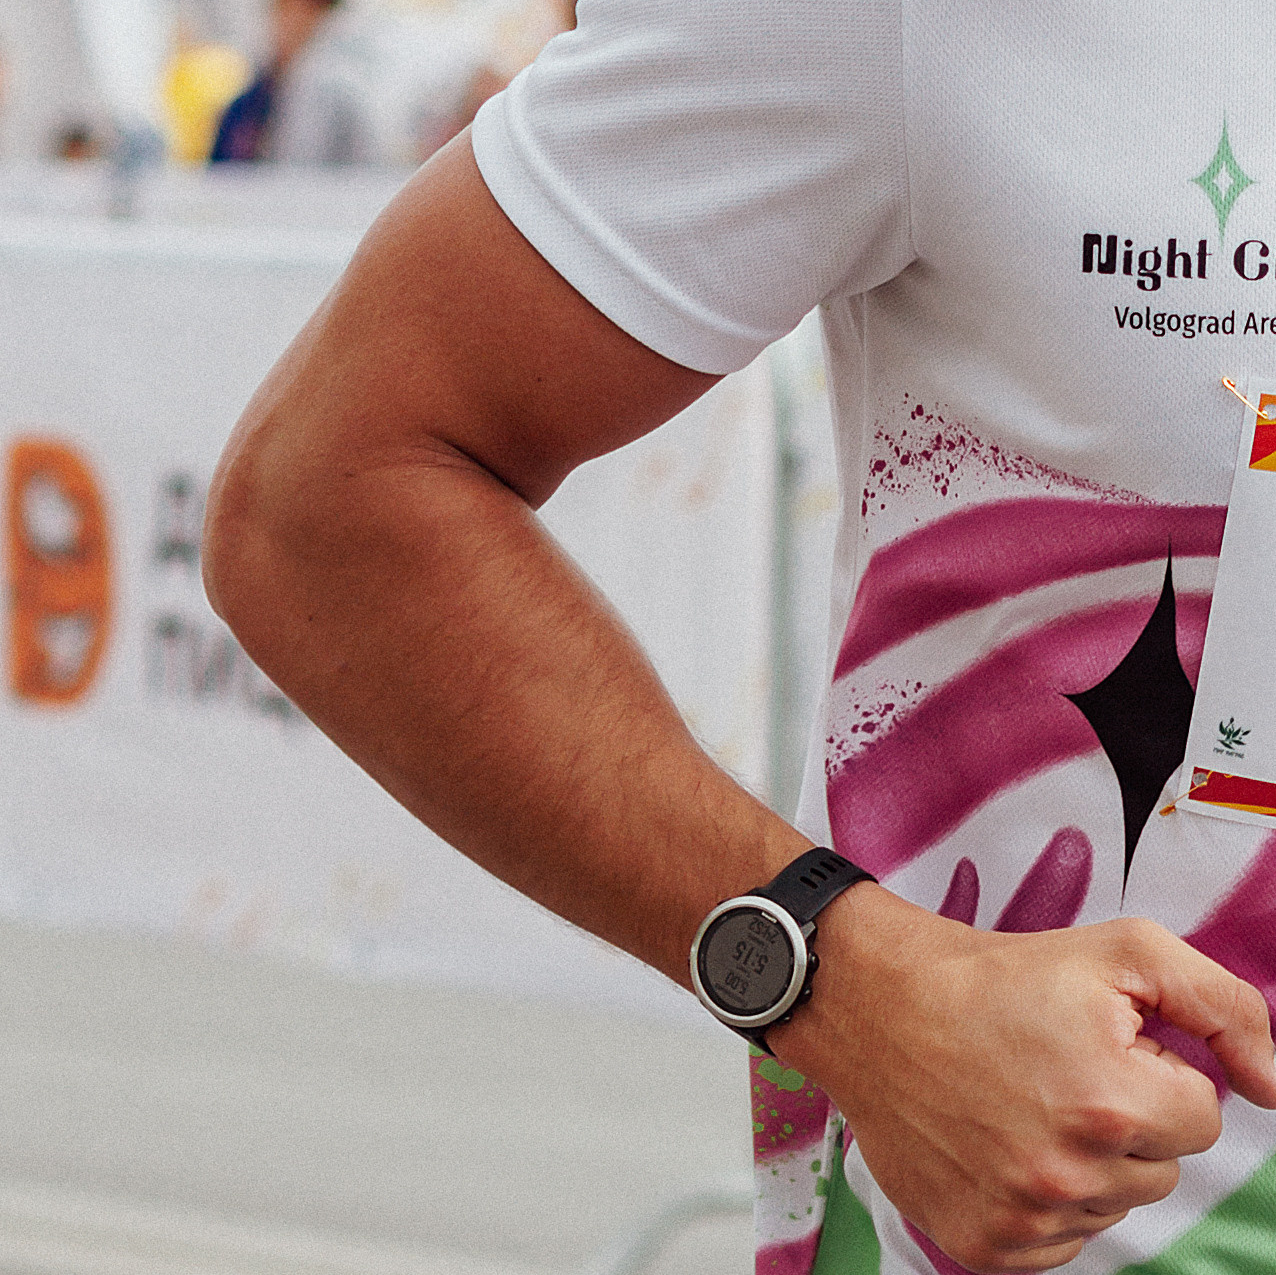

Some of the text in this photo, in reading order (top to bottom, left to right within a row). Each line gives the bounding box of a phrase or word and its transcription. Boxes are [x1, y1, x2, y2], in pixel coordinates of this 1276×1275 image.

[1082, 233, 1213, 291] Night
[1114, 306, 1235, 339] Volgograd
[732, 941, 769, 976] 5:15
